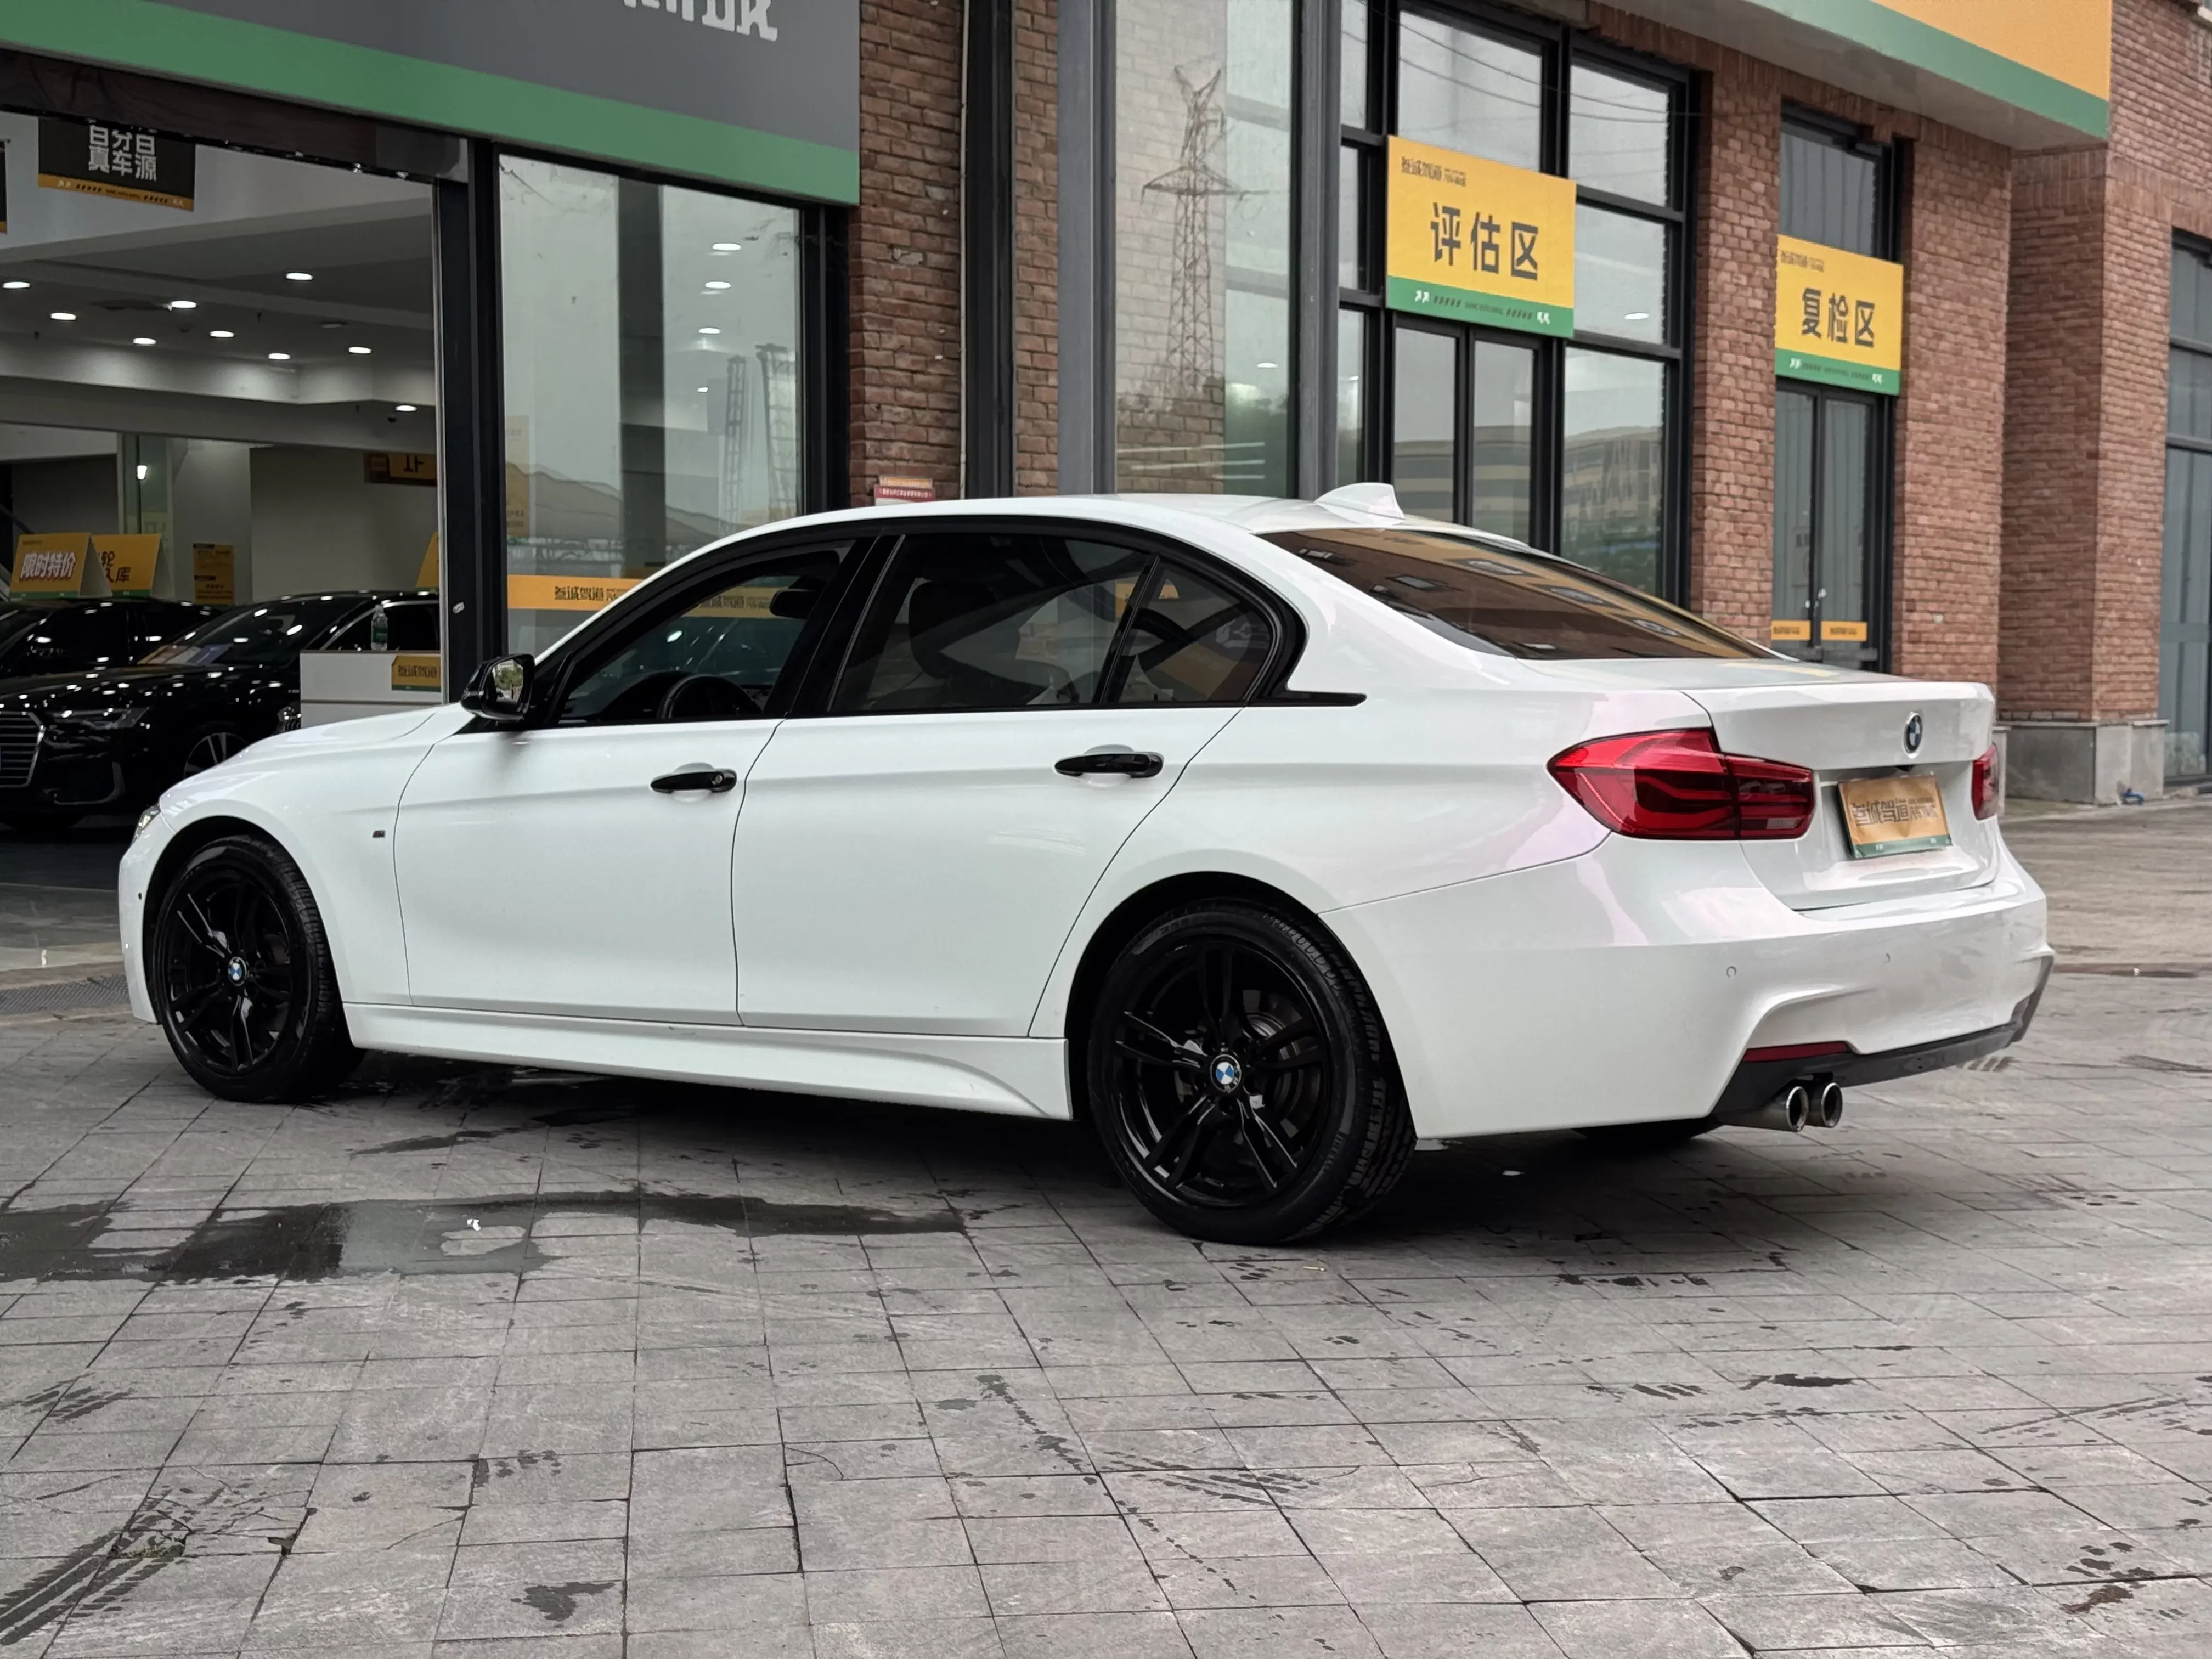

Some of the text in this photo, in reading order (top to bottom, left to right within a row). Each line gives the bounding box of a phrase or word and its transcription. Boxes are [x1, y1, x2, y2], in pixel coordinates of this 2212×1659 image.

[88, 145, 157, 182] 真车源
[1430, 202, 1539, 281] 评估区
[1801, 287, 1875, 348] 复检区
[20, 550, 76, 580] 限时特价
